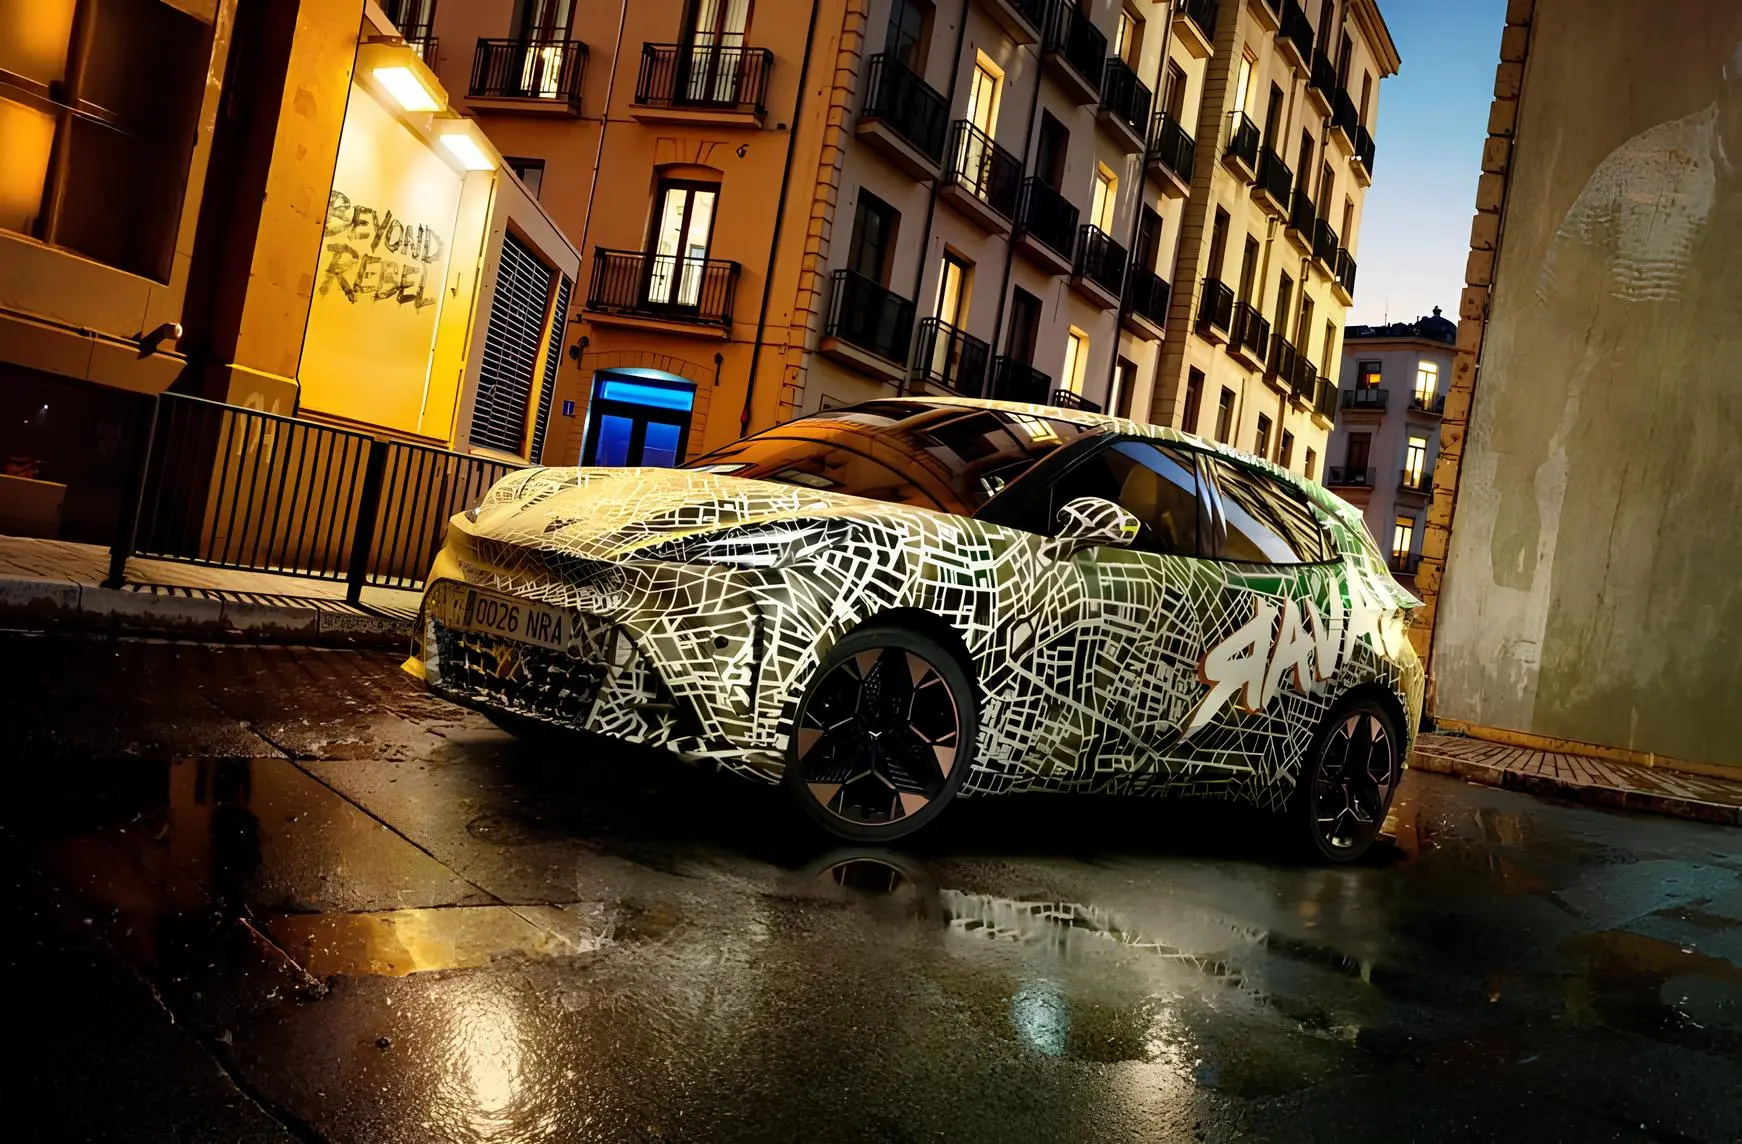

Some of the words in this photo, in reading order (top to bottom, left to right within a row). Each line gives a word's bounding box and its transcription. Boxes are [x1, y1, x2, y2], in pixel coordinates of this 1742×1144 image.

[325, 190, 443, 264] BEYOND
[319, 243, 436, 311] REBEL
[476, 598, 520, 632] 0026
[526, 610, 562, 646] NRA
